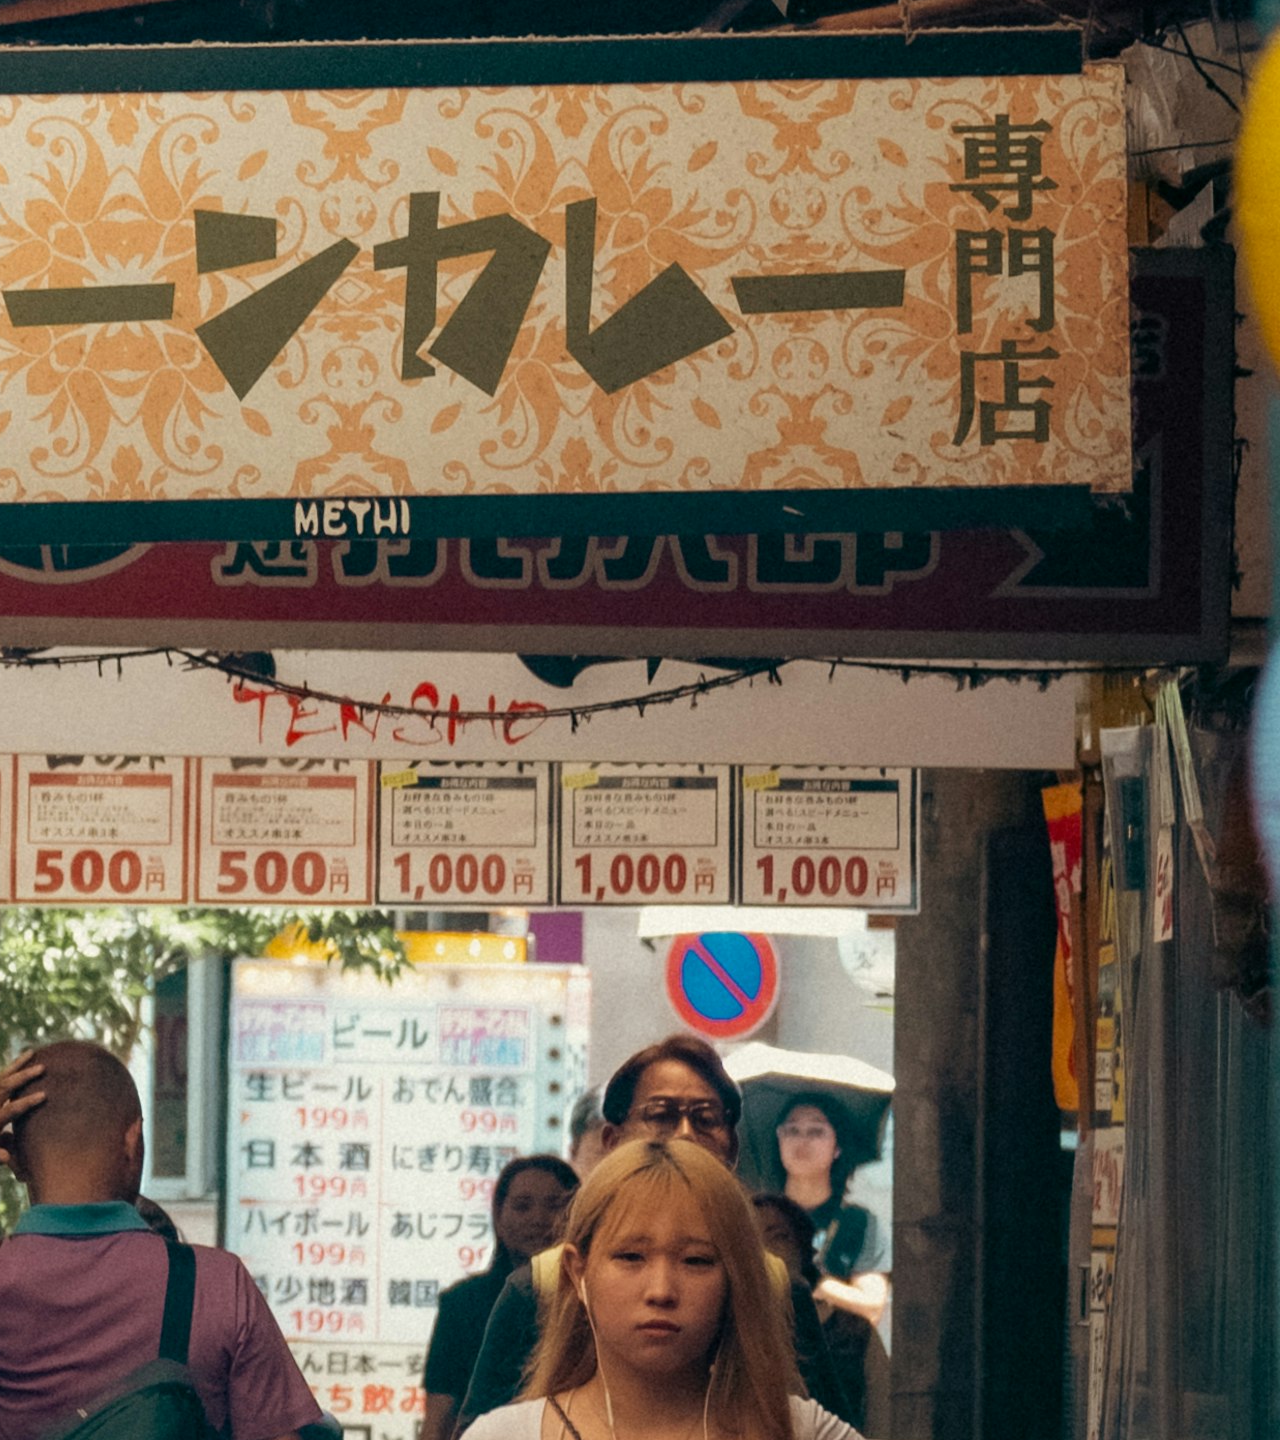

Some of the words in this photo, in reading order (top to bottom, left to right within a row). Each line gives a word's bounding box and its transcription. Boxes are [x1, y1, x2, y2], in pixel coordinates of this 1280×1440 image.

[949, 113, 1060, 448] 専門店
[293, 498, 411, 538] METHI
[34, 849, 165, 894] 500円
[216, 850, 349, 895] 500円
[393, 852, 534, 901] 1,000円
[574, 852, 715, 902] 1,000円
[756, 854, 896, 903] 1,000円
[332, 1013, 428, 1050] ビール
[245, 1073, 374, 1103] 生ビール
[296, 1107, 369, 1130] 199円
[459, 1110, 519, 1132] 99円
[245, 1139, 372, 1173] 日本酒
[293, 1174, 368, 1199] 199円
[243, 1209, 370, 1237] ハイボール
[292, 1241, 366, 1266] 199円
[291, 1310, 366, 1333] 199円
